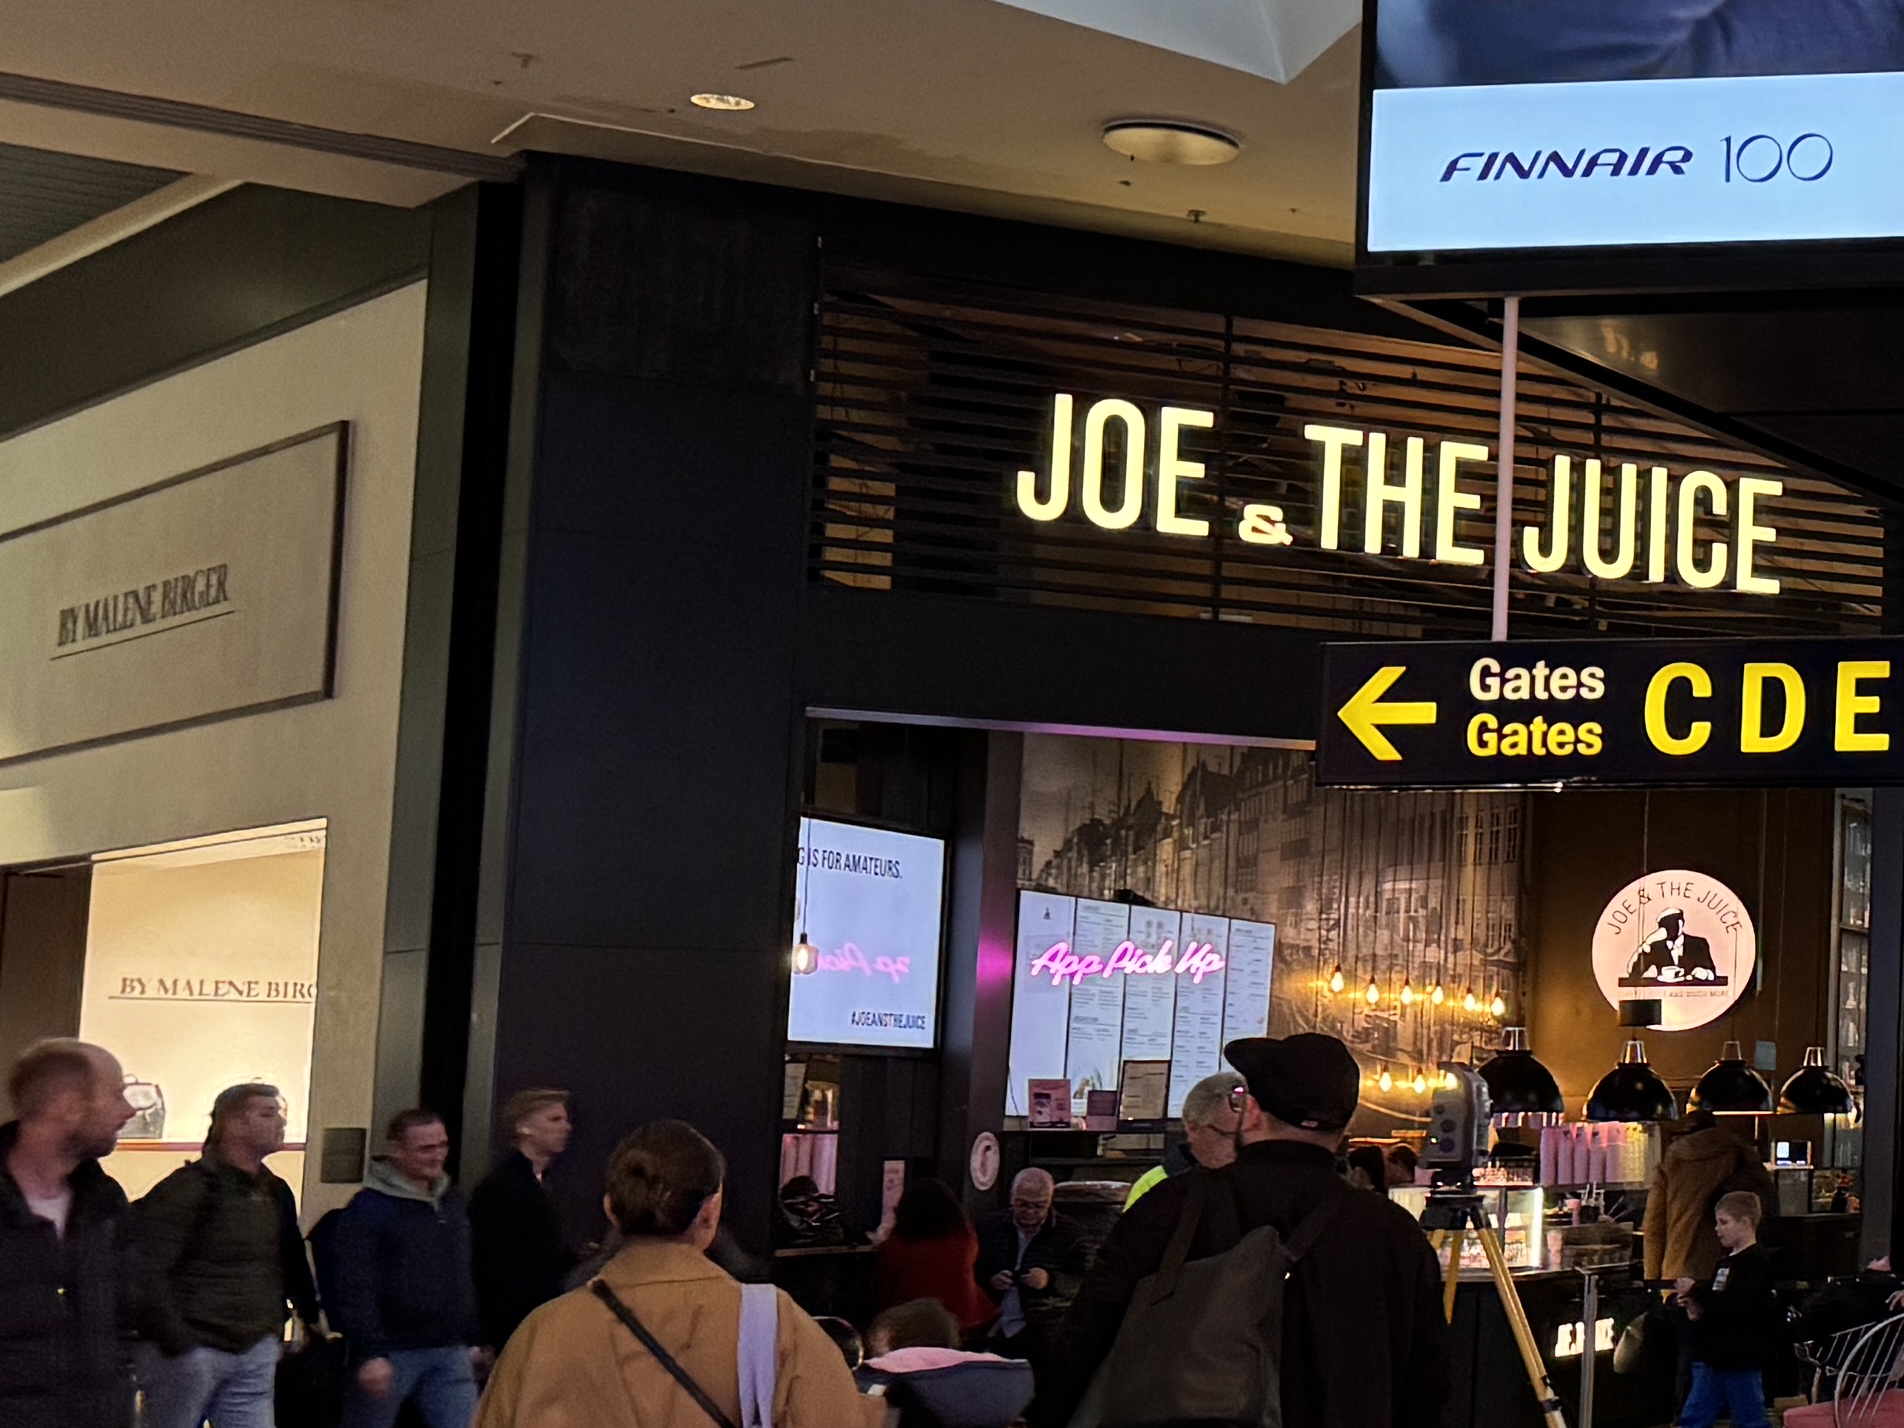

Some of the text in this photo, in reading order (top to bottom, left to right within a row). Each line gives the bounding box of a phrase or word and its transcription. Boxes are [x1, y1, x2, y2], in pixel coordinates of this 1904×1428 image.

[1440, 133, 1834, 184] FINNAIR 100
[1016, 393, 1783, 595] JOE & THE JUICE
[57, 563, 229, 647] BY MALENE BIRGER
[1470, 658, 1605, 702] Gates
[1467, 713, 1603, 757] Gates
[821, 849, 842, 871] FOR
[843, 852, 902, 879] AMATEURS.
[1607, 881, 1743, 935] JOE & THE JUICE
[1031, 940, 1226, 985] App Pick Up
[119, 977, 147, 995] BY
[157, 977, 260, 998] MALENE
